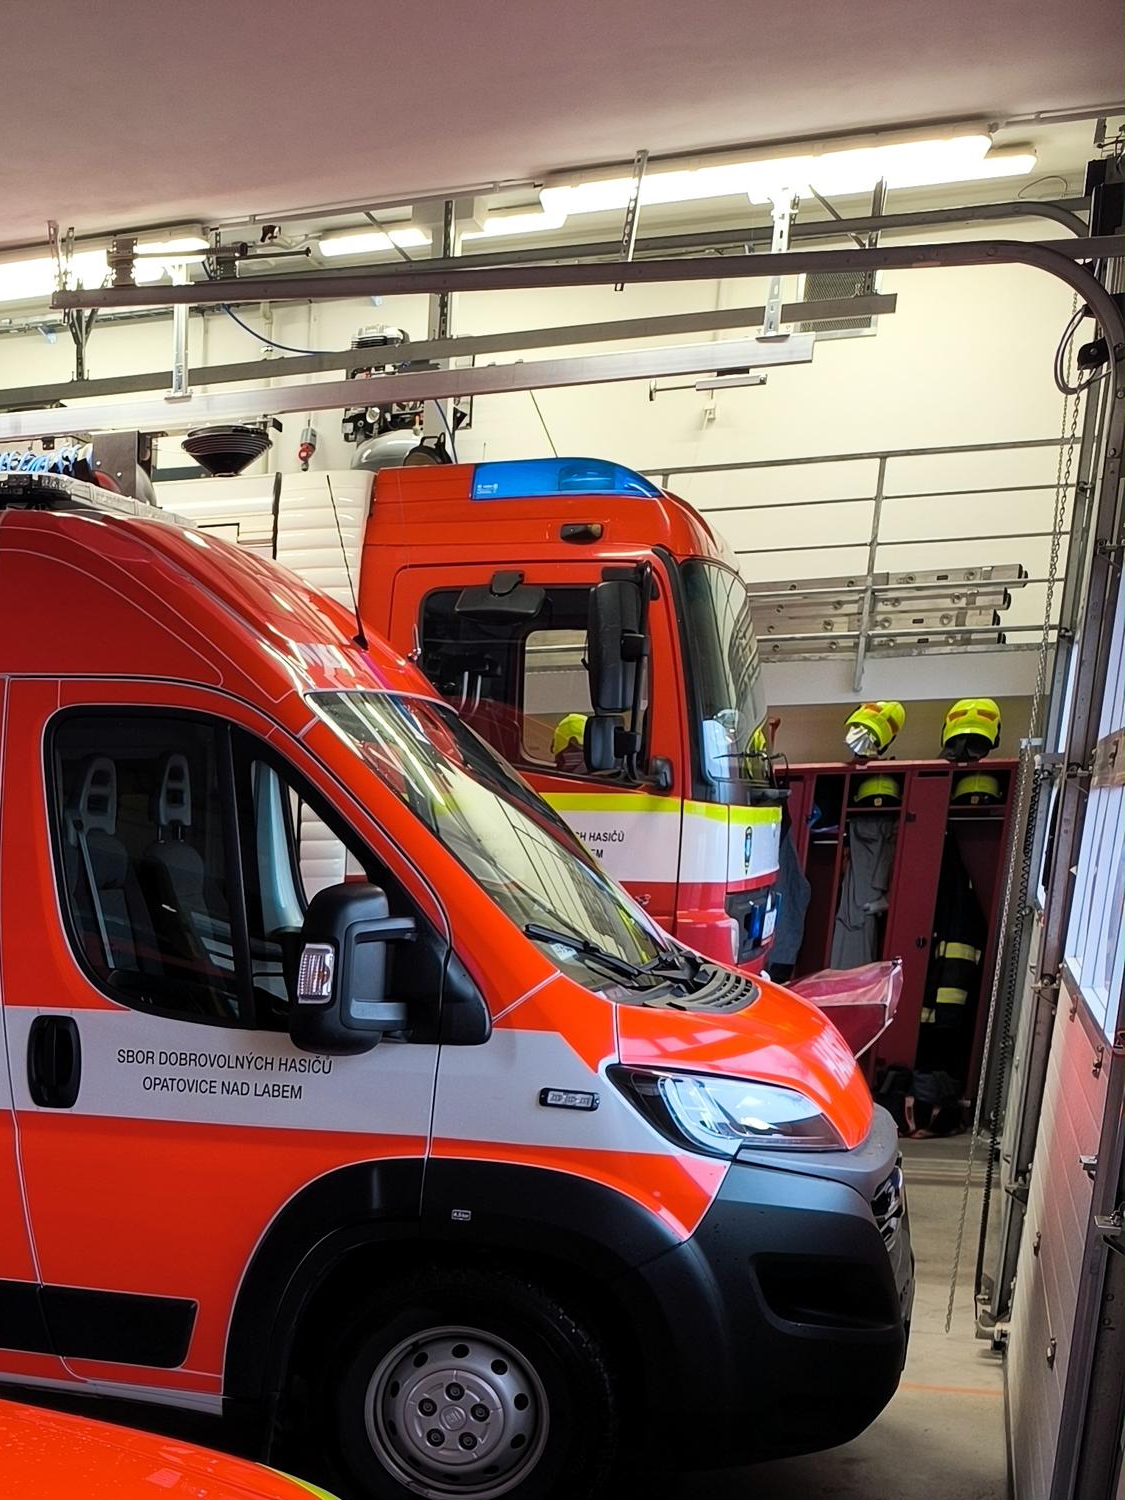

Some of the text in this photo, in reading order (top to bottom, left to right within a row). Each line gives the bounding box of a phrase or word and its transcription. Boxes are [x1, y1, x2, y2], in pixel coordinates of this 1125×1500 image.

[117, 1049, 333, 1074] SBOR DOBROVOLNÝCH HASIČŮ
[142, 1076, 303, 1099] OPATOVICE NAD LABEM
